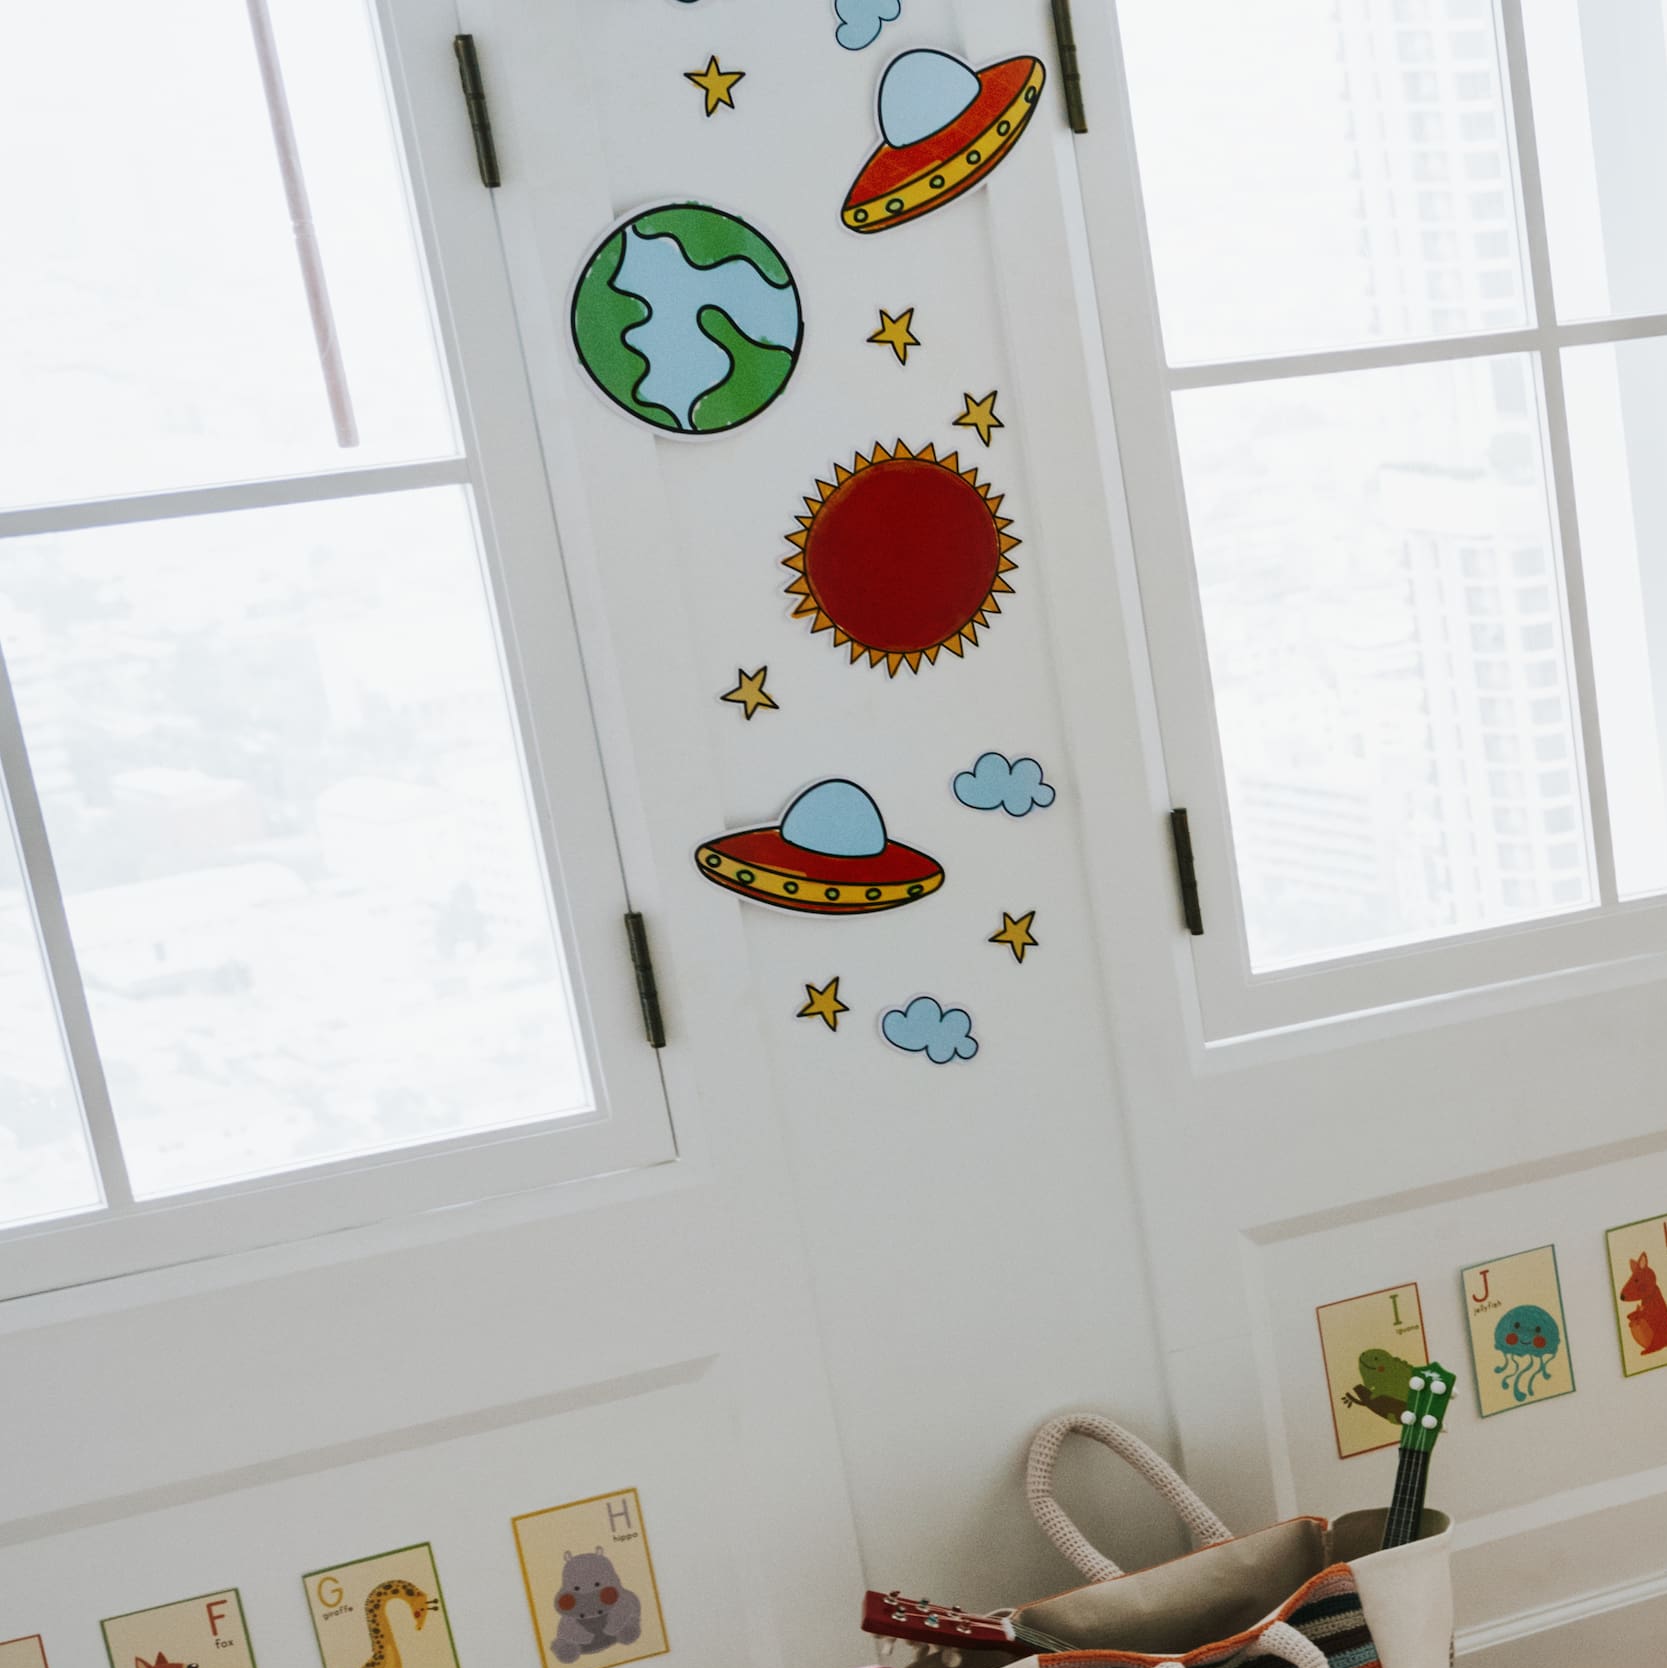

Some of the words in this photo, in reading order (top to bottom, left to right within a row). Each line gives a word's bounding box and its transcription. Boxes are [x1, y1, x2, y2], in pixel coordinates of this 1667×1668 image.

[1471, 1269, 1491, 1304] J
[1389, 1294, 1403, 1326] I
[606, 1498, 632, 1533] H
[612, 1532, 639, 1544] hippo
[316, 1575, 344, 1609] G
[205, 1598, 228, 1637] F
[322, 1604, 354, 1622] giraffe
[214, 1637, 235, 1650] fox
